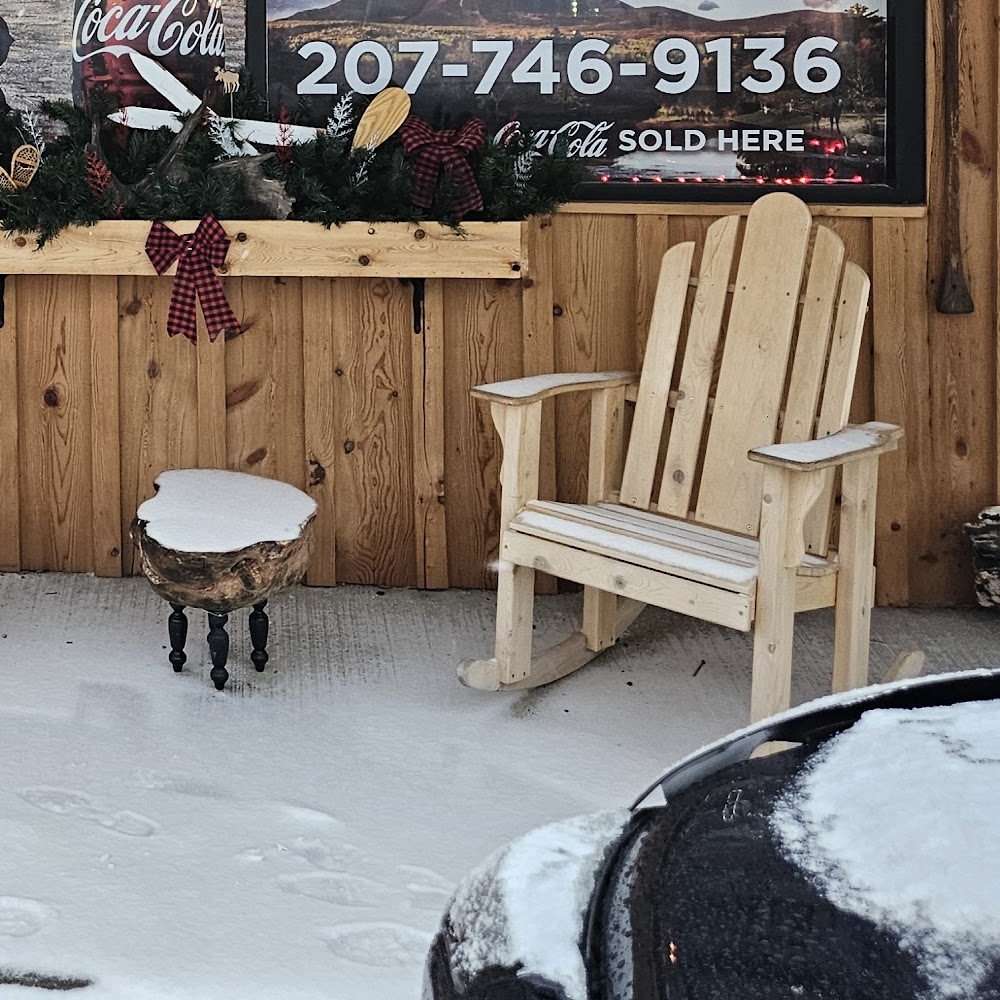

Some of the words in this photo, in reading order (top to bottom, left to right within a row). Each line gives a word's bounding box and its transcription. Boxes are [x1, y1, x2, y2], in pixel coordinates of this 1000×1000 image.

[297, 36, 843, 95] 207-746-9136
[618, 129, 707, 153] SOLD
[717, 128, 805, 152] HERE
